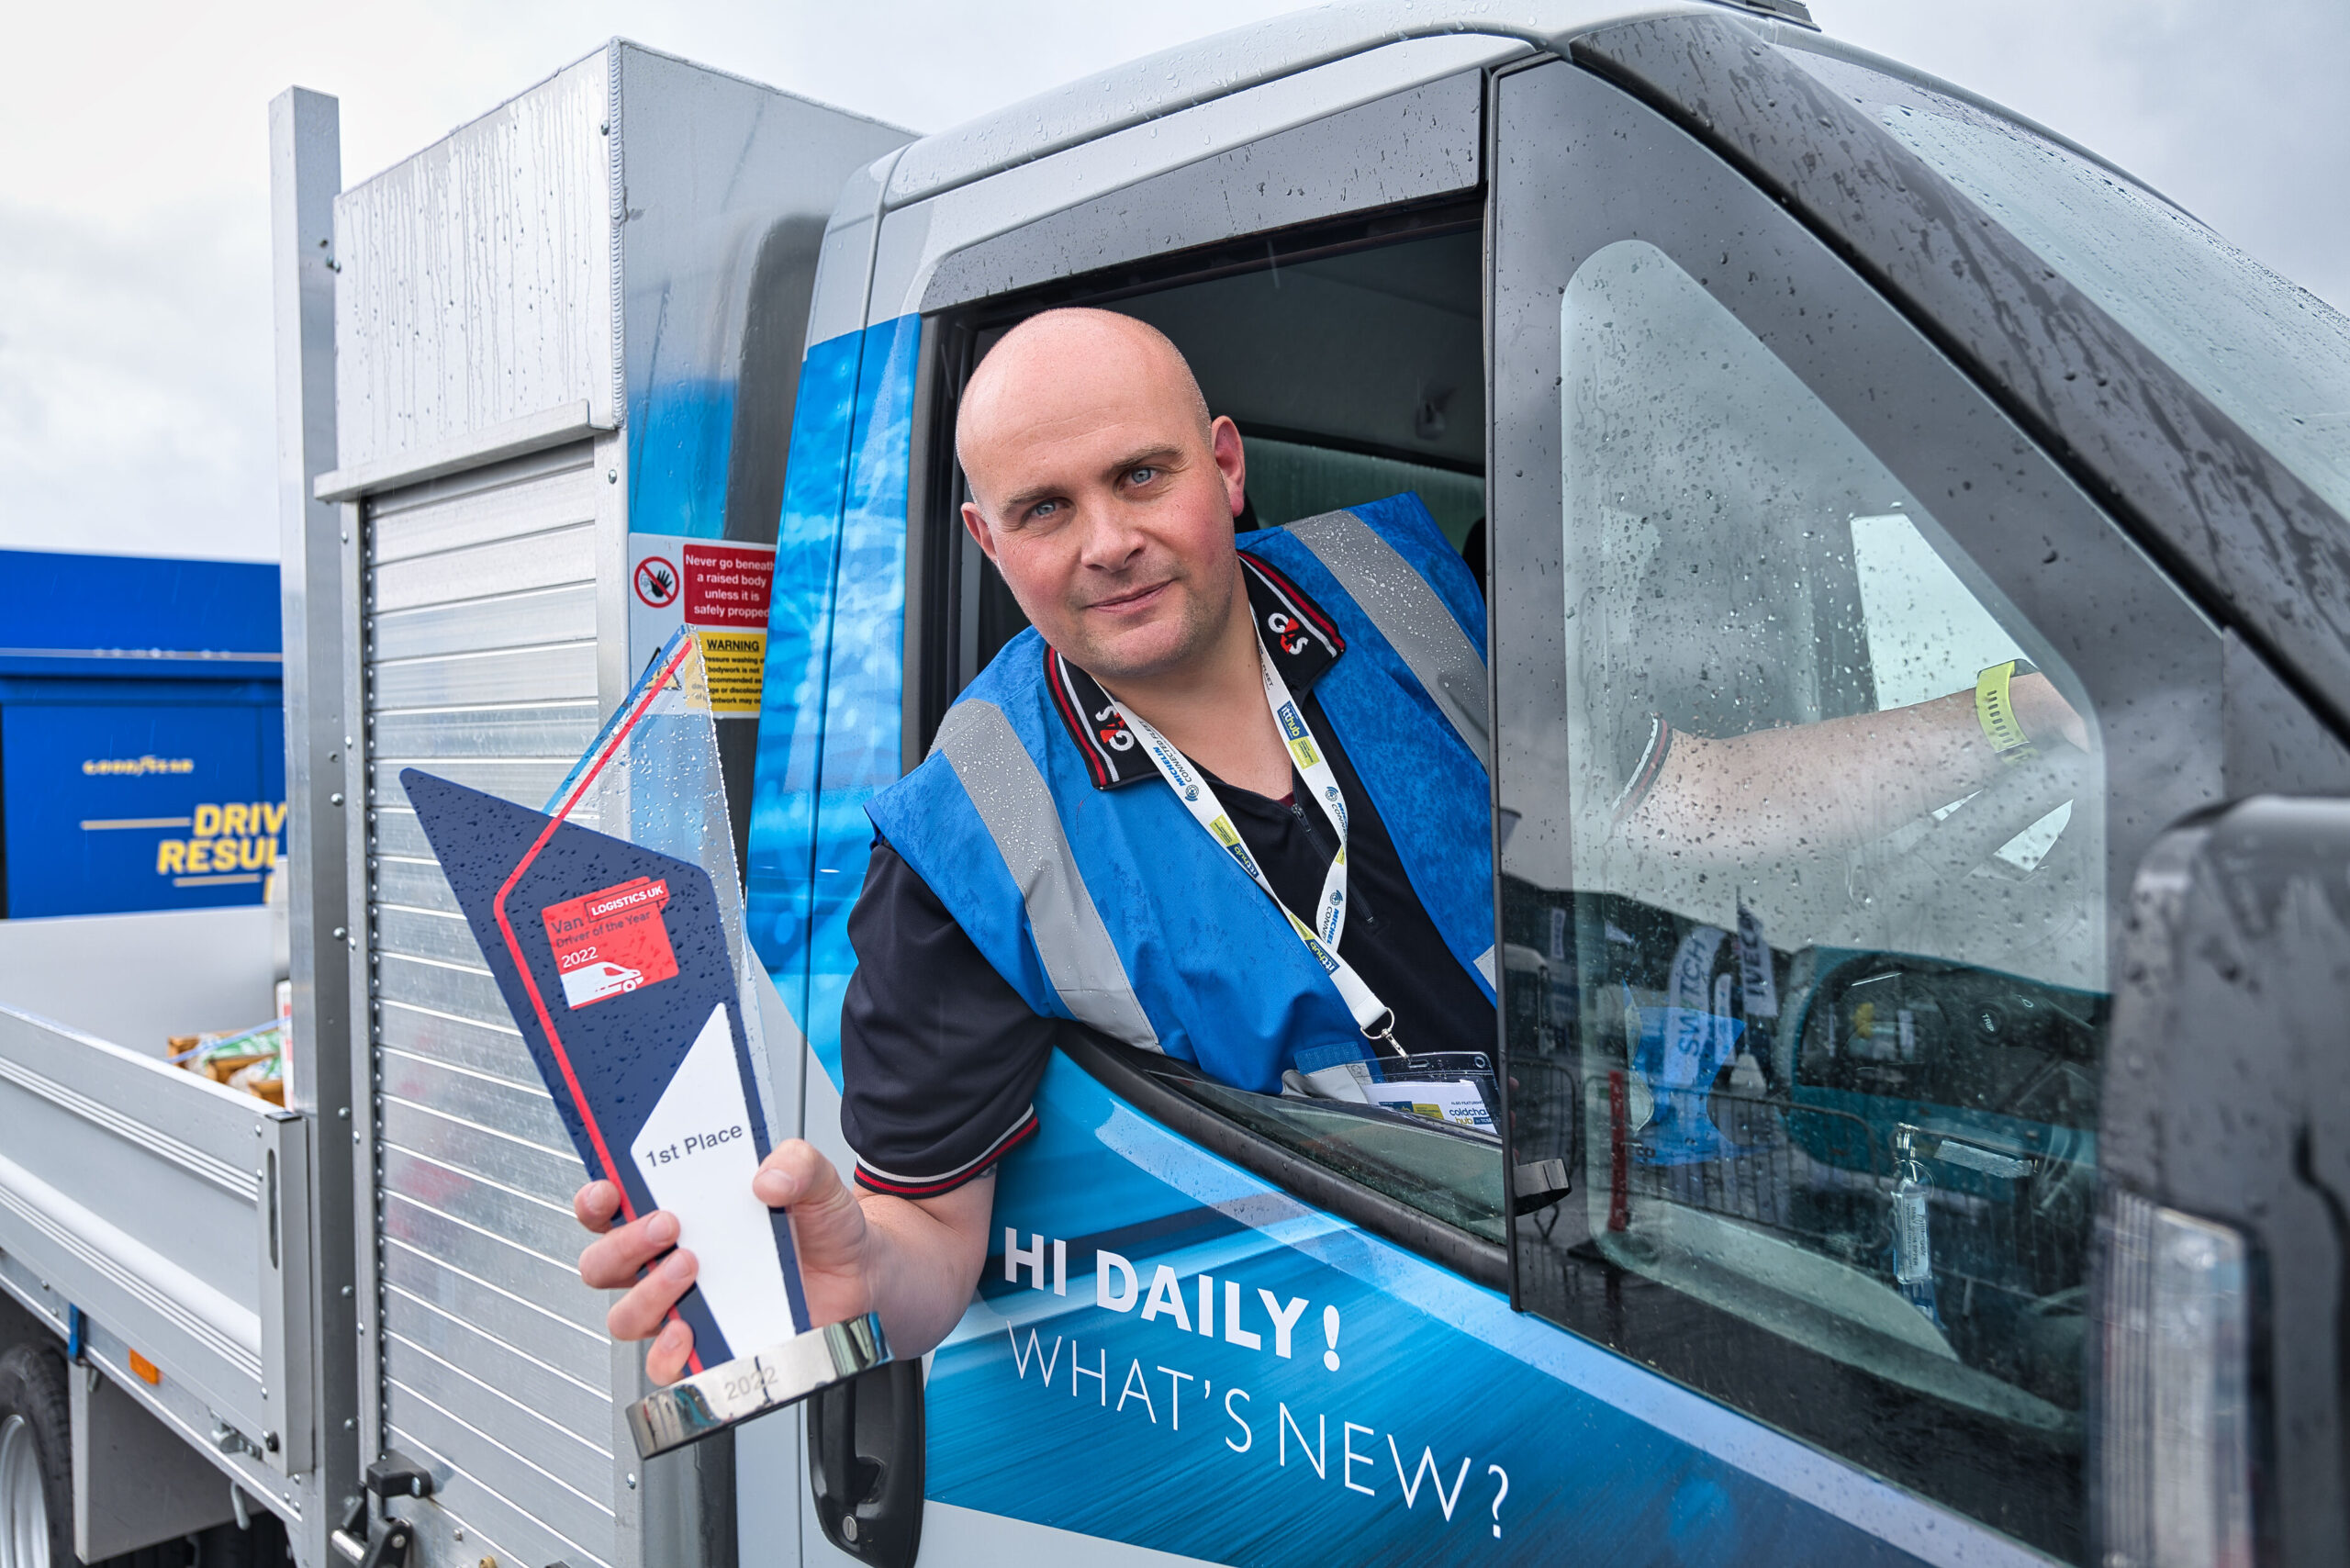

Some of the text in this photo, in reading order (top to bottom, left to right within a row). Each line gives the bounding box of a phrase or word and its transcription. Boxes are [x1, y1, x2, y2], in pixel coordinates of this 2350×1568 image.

[686, 554, 717, 566] Never
[720, 559, 733, 570] go
[697, 573, 767, 588] a raised body
[705, 589, 760, 601] unless it is
[694, 605, 725, 618] safely
[706, 639, 760, 652] WARNING
[1268, 612, 1309, 655] G4S
[732, 655, 757, 665] washing
[1280, 705, 1301, 737] itthub
[1153, 746, 1187, 787] MICHELIN
[1156, 740, 1192, 783] CONNECTED
[591, 885, 664, 916] LOGISTICS UK
[551, 917, 584, 934] Van
[555, 911, 651, 947] Driver of the Year
[561, 946, 599, 969] 2022
[1309, 940, 1336, 972] itthub
[1981, 1012, 1995, 1033] TRIP
[1455, 1116, 1474, 1126] hub
[645, 1124, 744, 1169] 1st Place
[1004, 1226, 1341, 1372] HI DAILY!
[723, 1365, 779, 1402] 2022
[1006, 1319, 1509, 1540] WHAT'S NEW?
